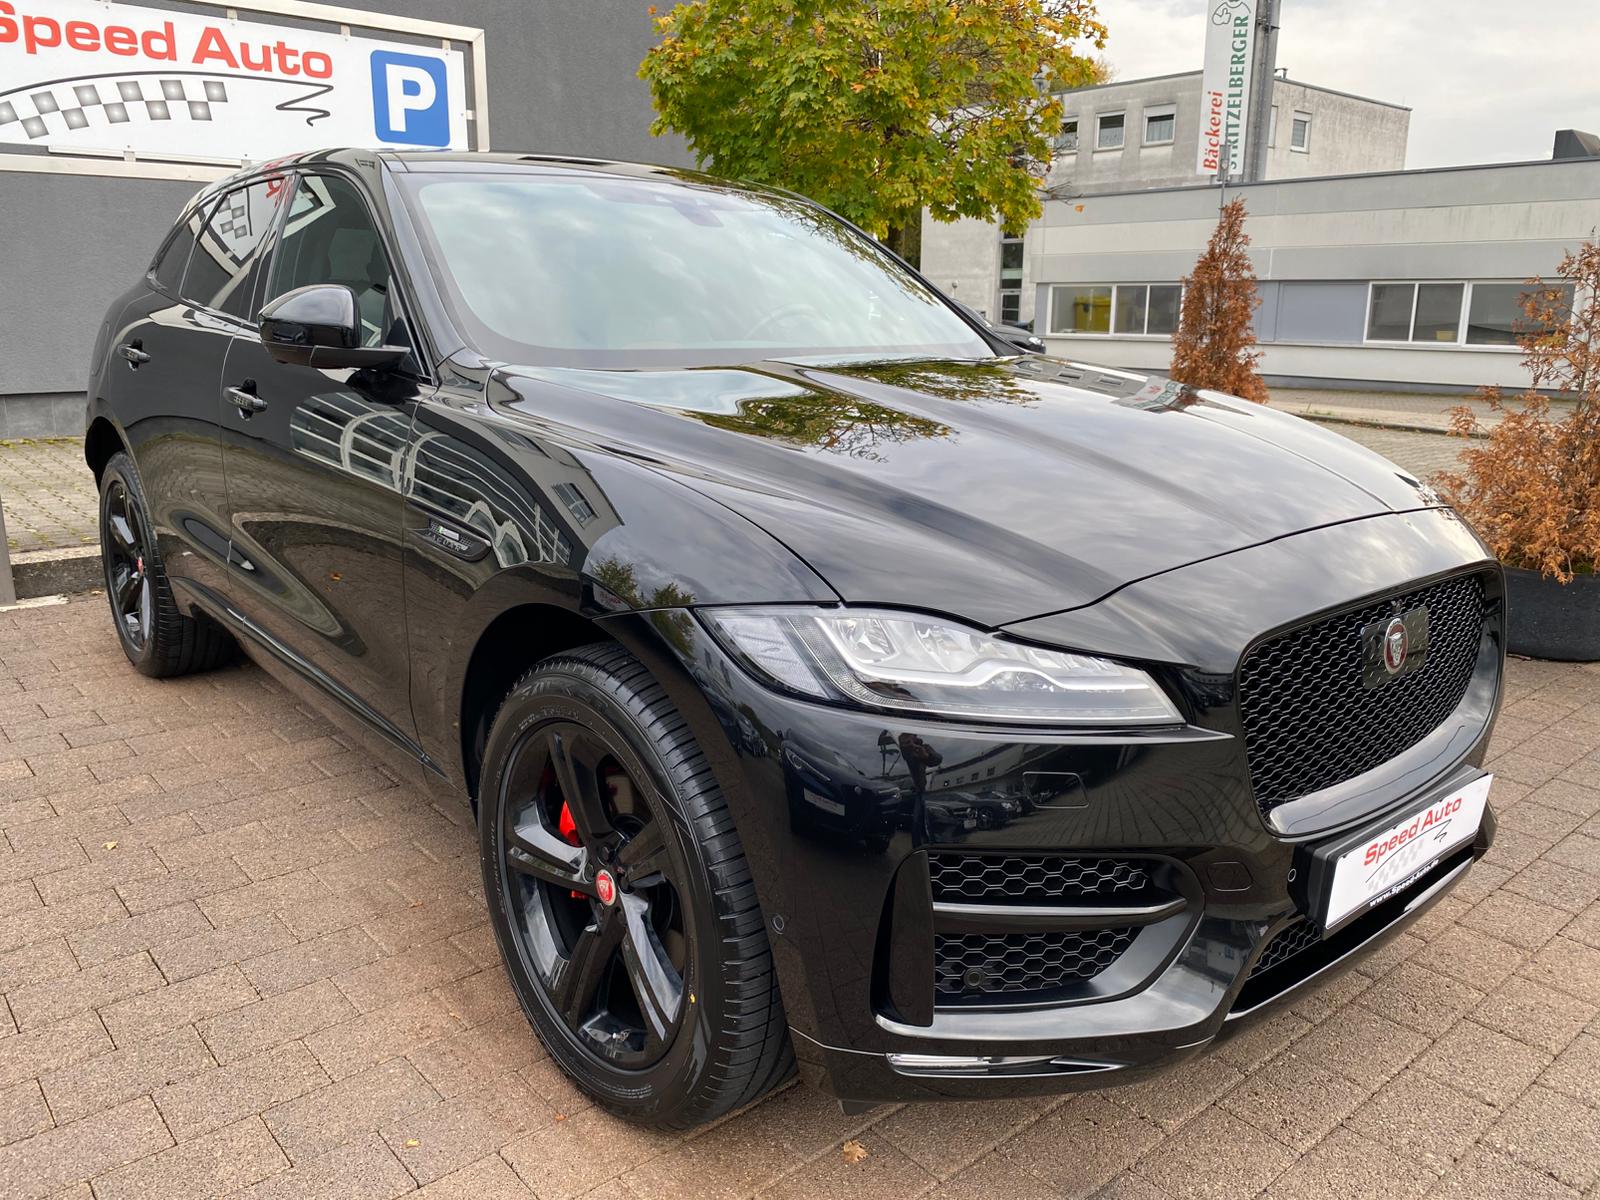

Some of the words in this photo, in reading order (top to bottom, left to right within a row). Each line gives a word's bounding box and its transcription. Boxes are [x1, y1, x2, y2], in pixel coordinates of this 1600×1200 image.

[191, 26, 333, 79] Auto
[386, 63, 437, 132] P
[1203, 91, 1224, 171] Bäckerei
[425, 531, 462, 552] JAGUAR
[1364, 817, 1421, 866] Speed
[1421, 798, 1463, 831] Auto
